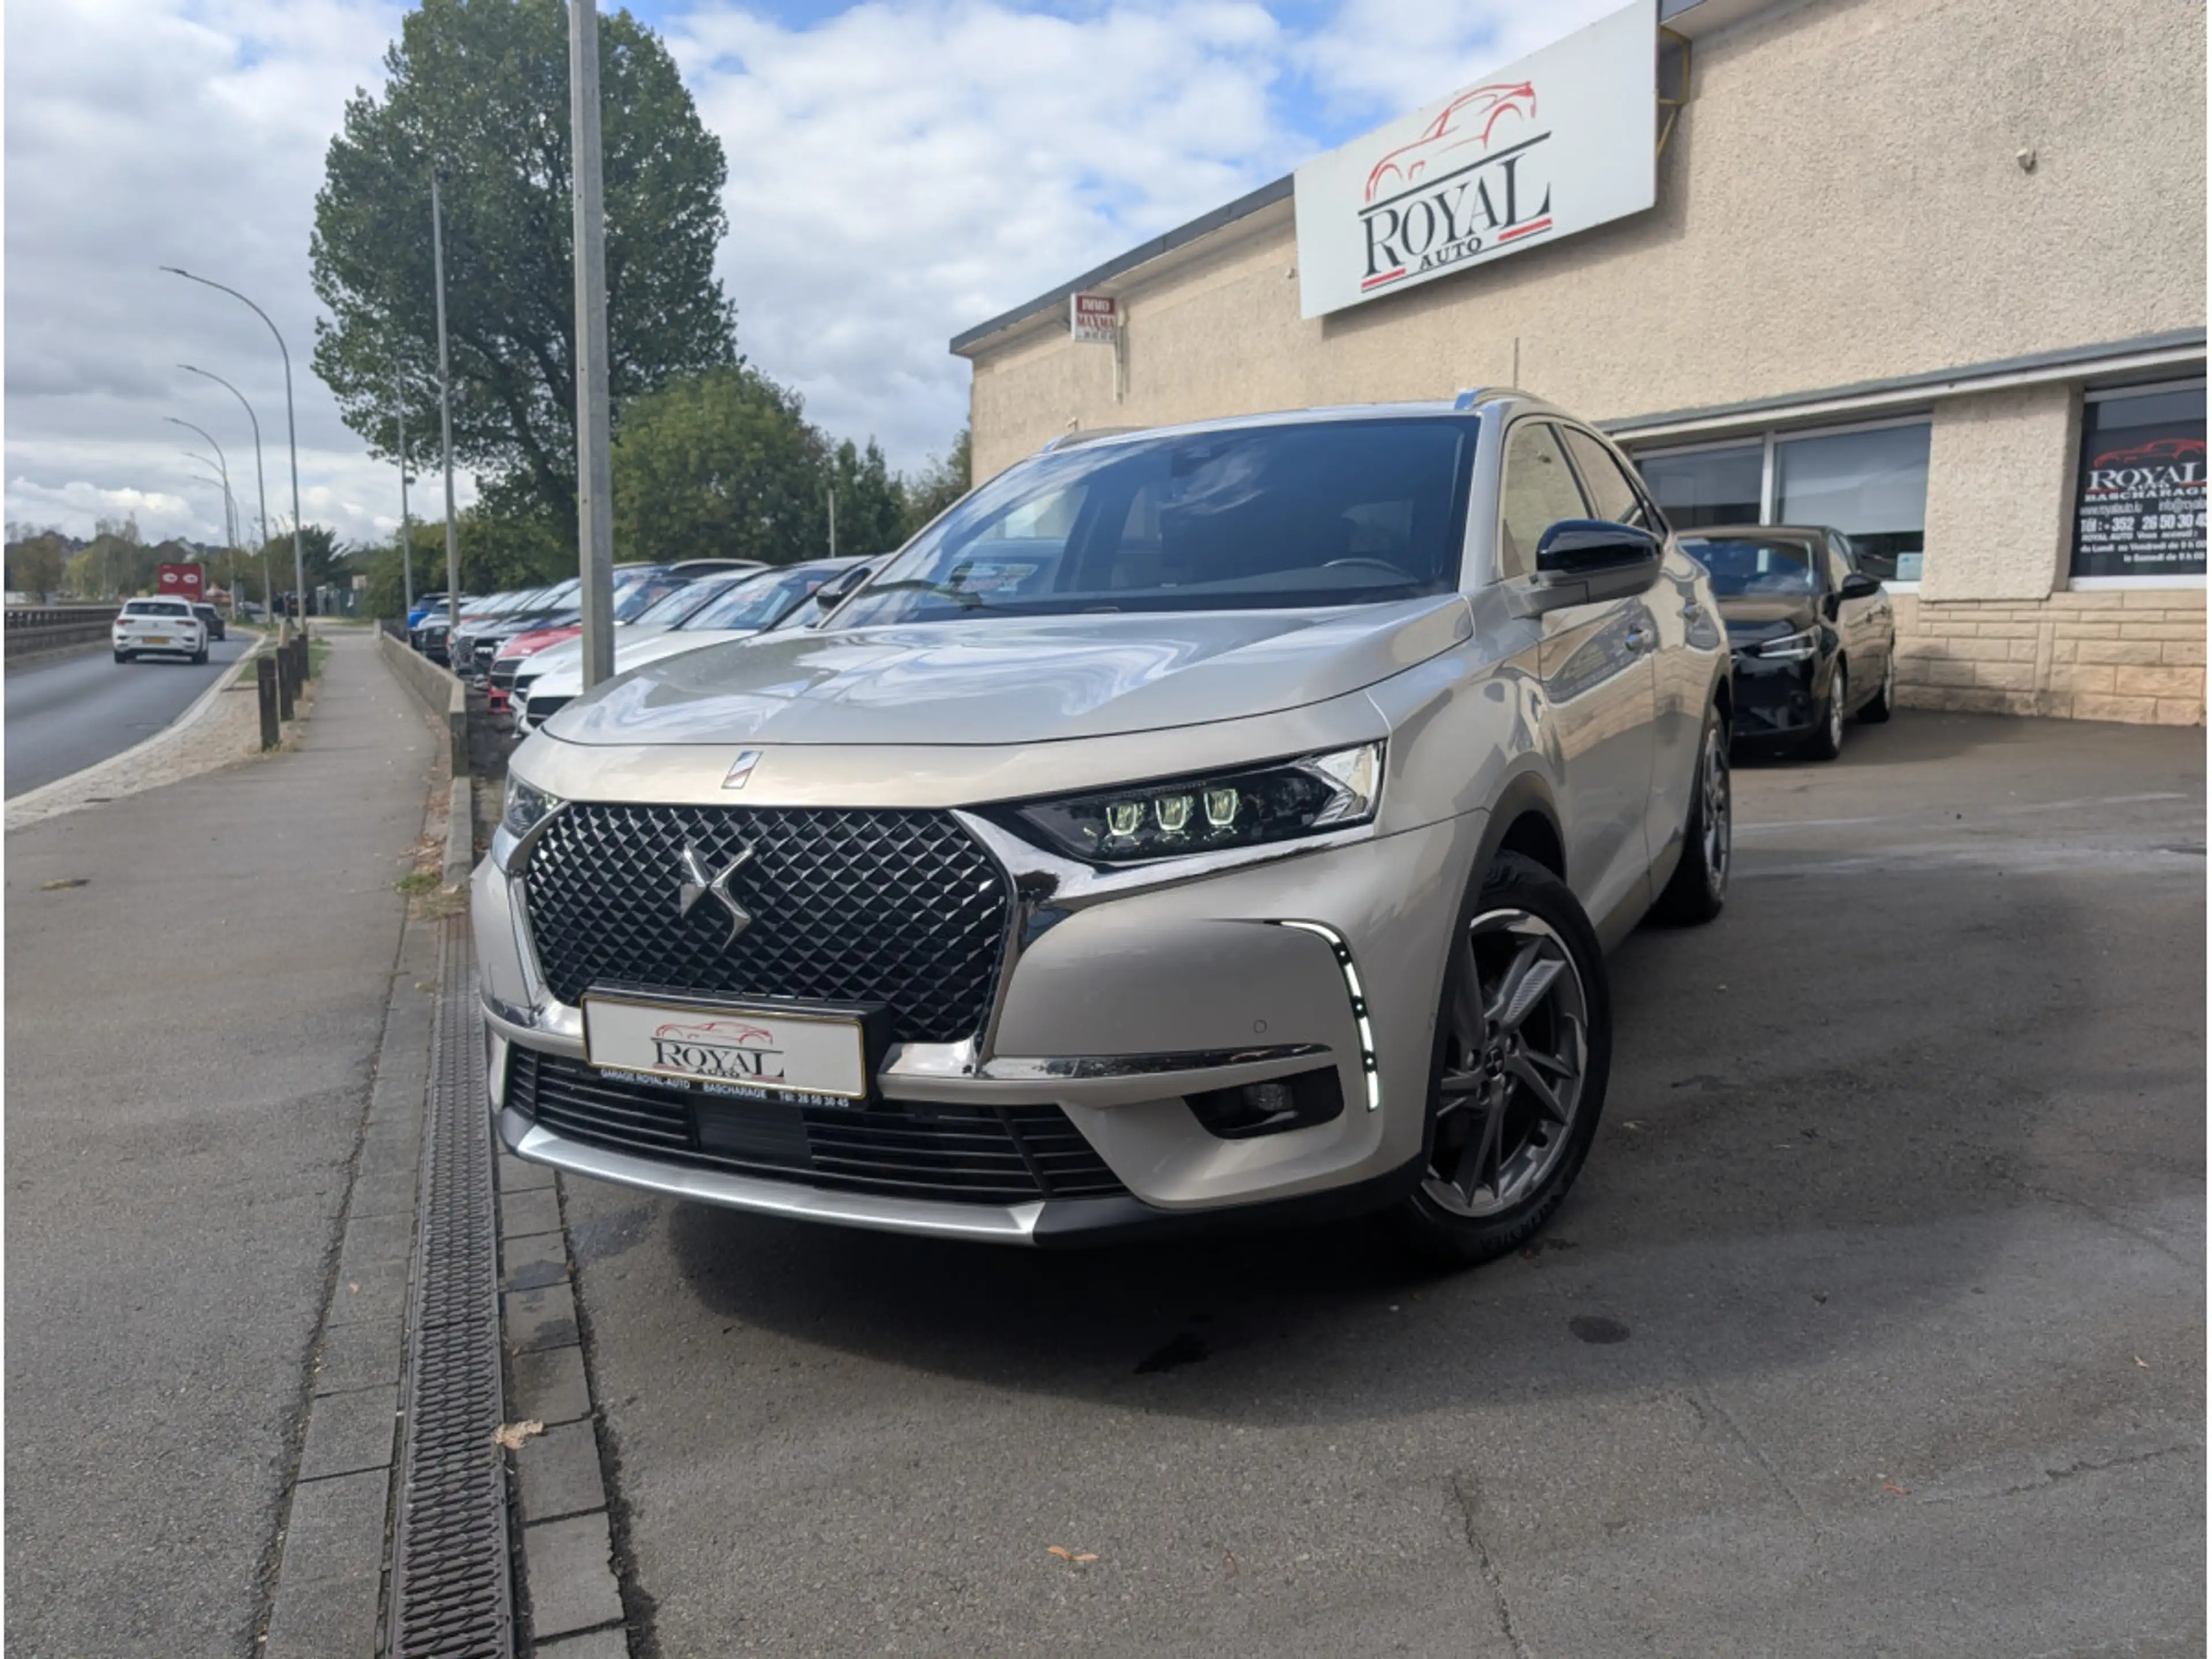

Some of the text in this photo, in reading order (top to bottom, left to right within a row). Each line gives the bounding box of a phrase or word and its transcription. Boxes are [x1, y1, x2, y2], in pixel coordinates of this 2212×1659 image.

[1361, 153, 1551, 278] ROYAL
[1419, 237, 1482, 270] AUTO
[1082, 298, 1109, 312] IMMO
[2088, 461, 2206, 490] ROYAL
[2159, 514, 2176, 530] 50
[2177, 513, 2194, 528] 30
[653, 1041, 785, 1078] ROYAL
[695, 1067, 740, 1079] AUTO
[601, 1069, 634, 1082] GARAGE
[702, 1082, 767, 1099] BASCHARAGE
